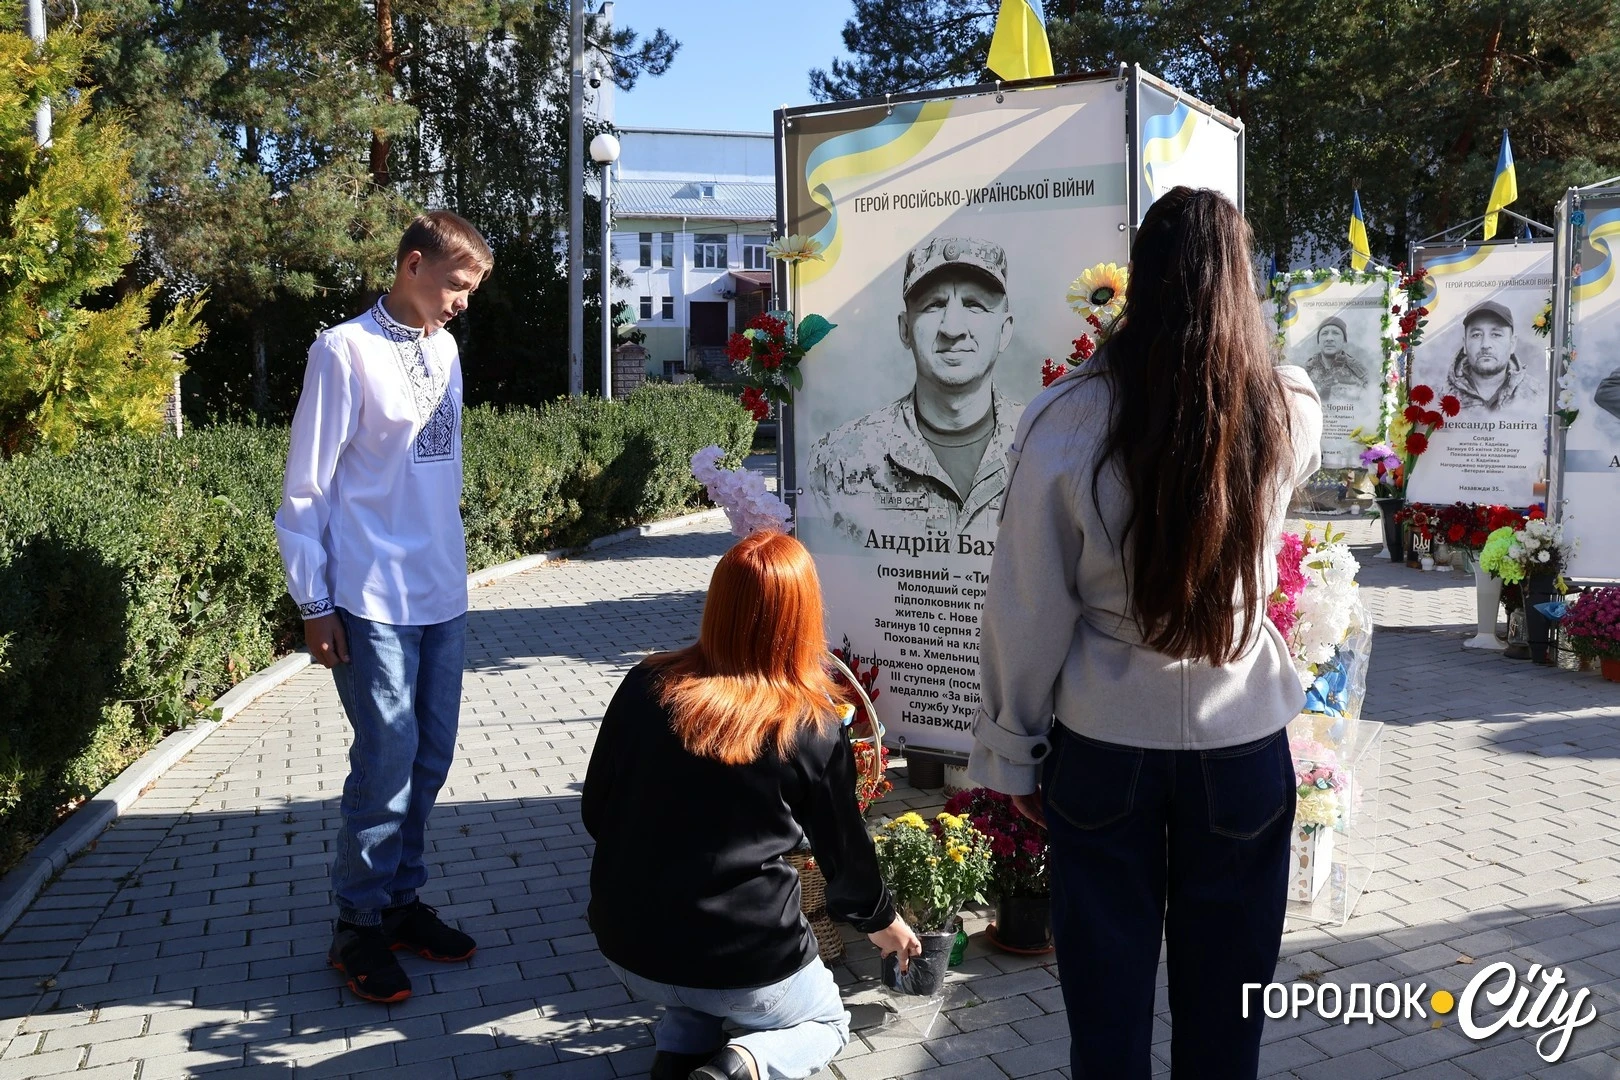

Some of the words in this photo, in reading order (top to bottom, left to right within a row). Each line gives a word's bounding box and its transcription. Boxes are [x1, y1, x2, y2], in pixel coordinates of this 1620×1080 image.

[854, 192, 890, 213] ГЕРОЙ
[893, 179, 1050, 211] РОСІЙСЬКО-УКРАЇНСЬКОЇ
[1053, 178, 1095, 199] ВІЙНИ
[1446, 281, 1463, 289] ГЕРОЙ
[1442, 421, 1496, 432] лександр
[1498, 420, 1538, 430] Баніта
[864, 528, 950, 558] Андрій
[877, 564, 949, 582] (позивний
[897, 581, 959, 596] Молодший
[894, 595, 971, 610] підполковник
[895, 608, 935, 620] житель
[938, 613, 946, 621] с.
[950, 612, 978, 624] Нове
[874, 618, 916, 632] Загинув
[919, 622, 930, 632] 10
[933, 626, 972, 637] серпня
[884, 632, 944, 647] Похований
[947, 640, 960, 649] на
[900, 648, 906, 656] в
[910, 650, 921, 658] м.
[923, 649, 980, 665] Хмельниц
[926, 663, 976, 677] орденом
[903, 674, 946, 687] ступеня
[949, 678, 981, 691] (посм
[890, 685, 939, 699] медаллю
[942, 690, 961, 701] «За
[909, 700, 950, 715] службу
[902, 710, 972, 732] Назавжди
